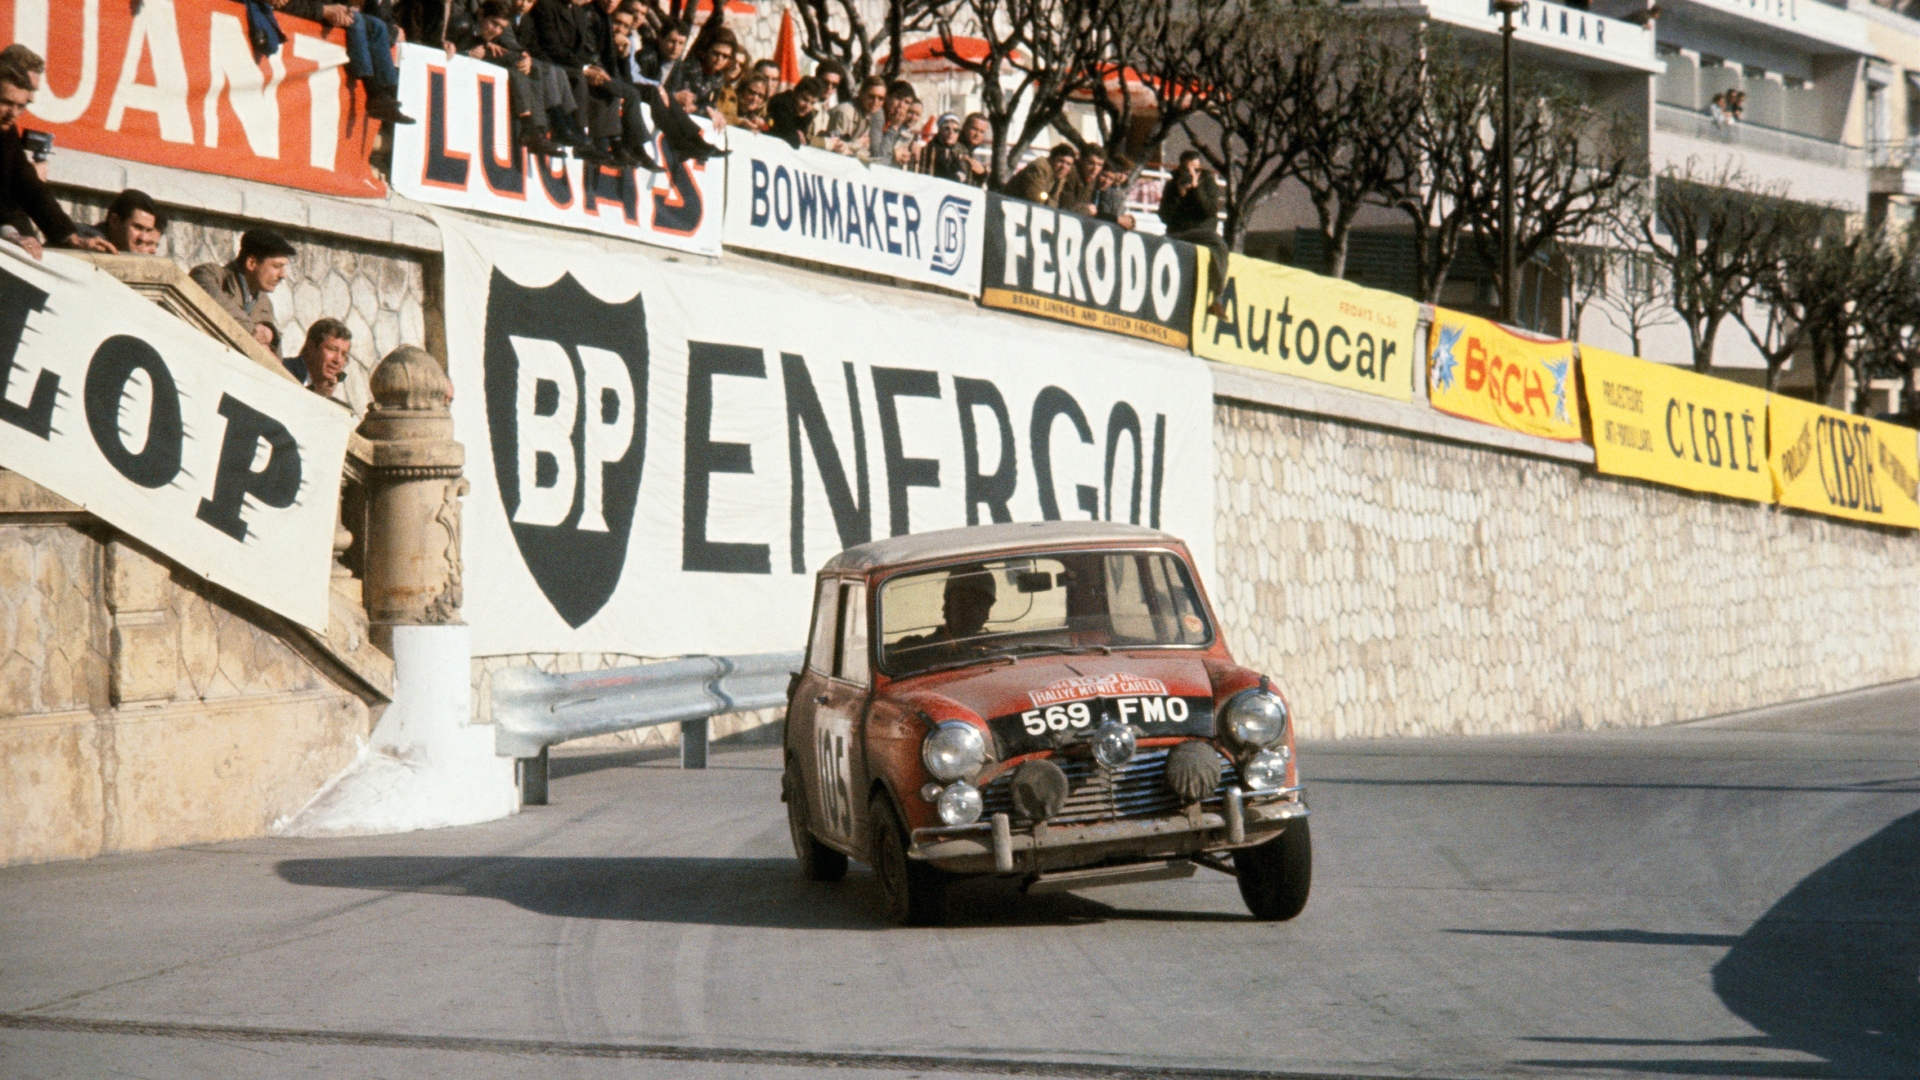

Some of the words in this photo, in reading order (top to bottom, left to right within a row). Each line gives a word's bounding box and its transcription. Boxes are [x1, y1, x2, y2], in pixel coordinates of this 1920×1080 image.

[1488, 0, 1604, 44] MRAMAR
[751, 158, 921, 260] BOWMAKER
[1001, 199, 1181, 322] FERODO
[1012, 294, 1041, 312] BRAKE
[1044, 299, 1076, 318] LININGS
[1082, 308, 1098, 323] AND
[1103, 311, 1132, 330] CLUTCH
[1134, 320, 1168, 340] FACINGS
[1212, 276, 1397, 382] Autocar
[1465, 337, 1551, 418] BSCH
[508, 336, 636, 532] BP
[1021, 702, 1091, 736] 569
[1117, 697, 1189, 724] FMO
[1036, 687, 1076, 703] RALLYE
